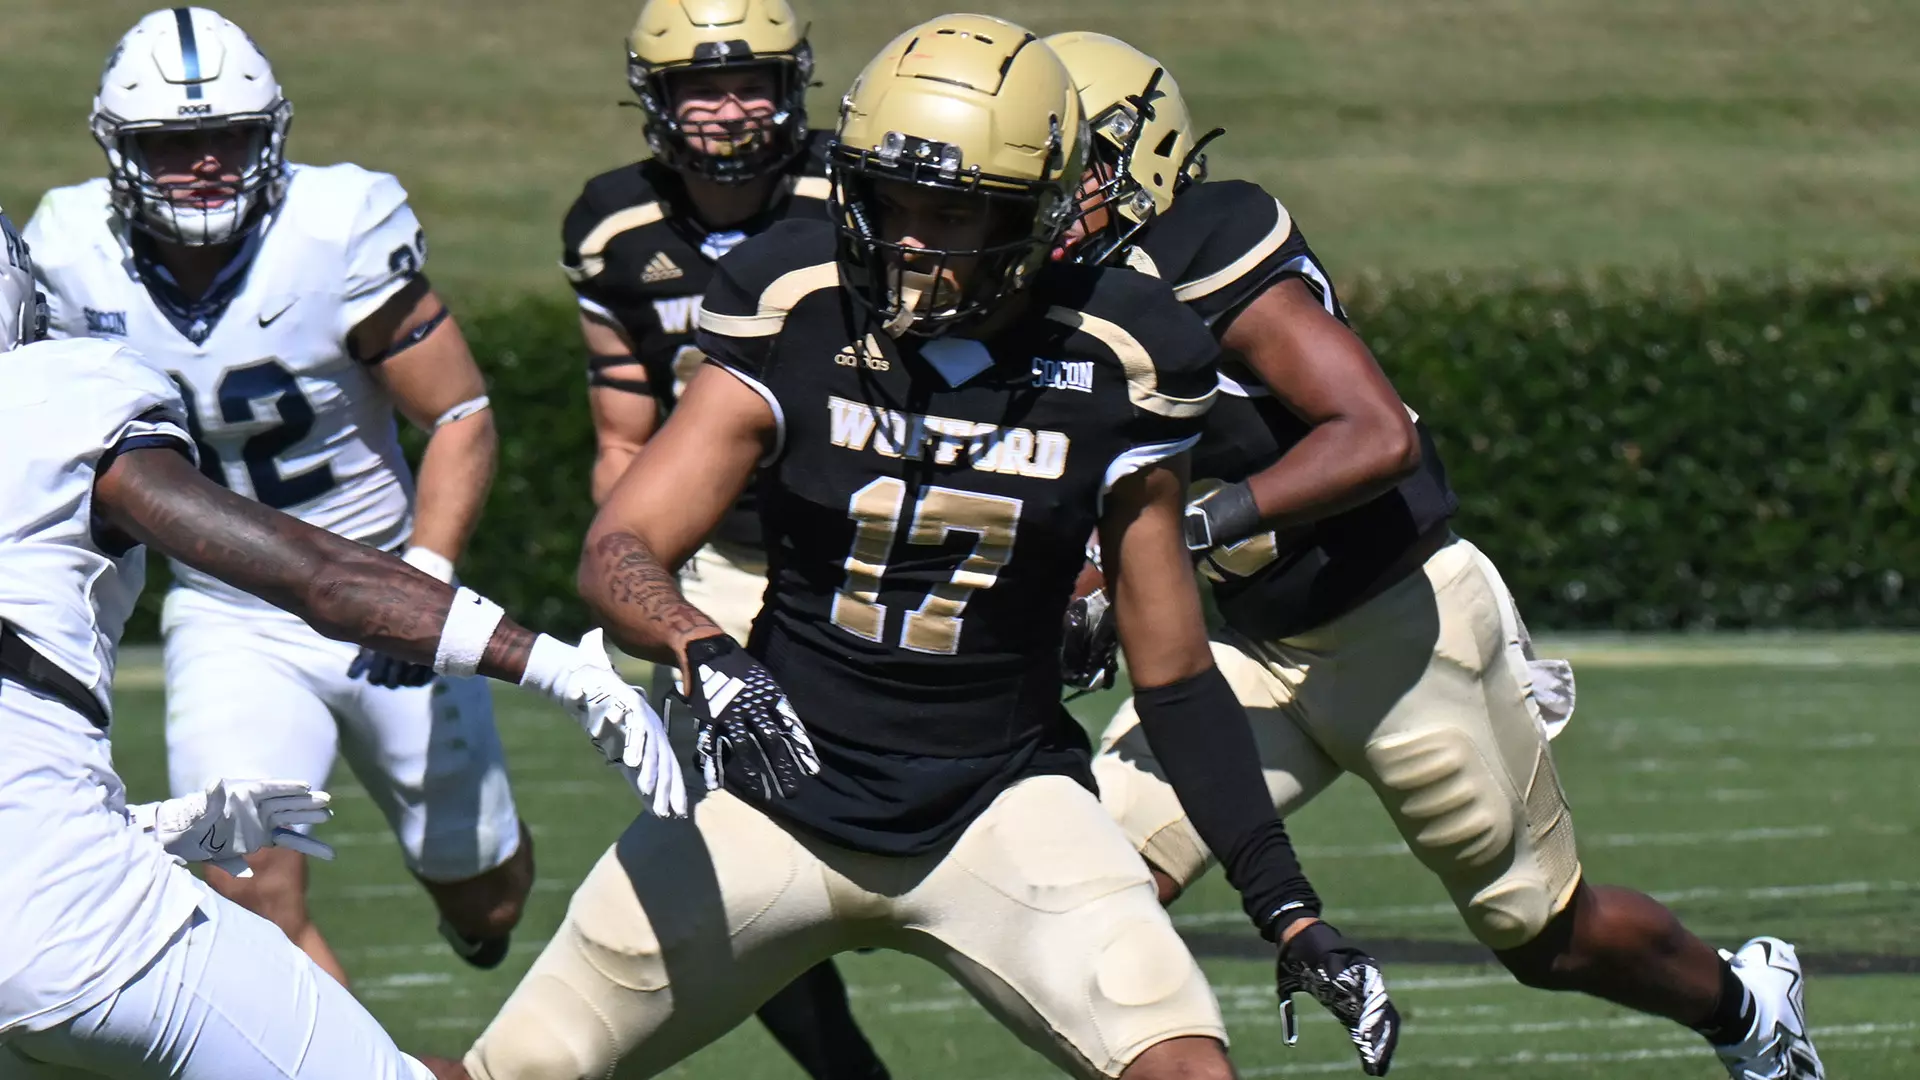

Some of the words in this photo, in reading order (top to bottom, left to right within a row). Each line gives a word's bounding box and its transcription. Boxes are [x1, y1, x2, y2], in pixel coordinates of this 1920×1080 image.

[1031, 356, 1095, 393] SOCON
[828, 395, 1071, 480] WOFFORD
[829, 475, 1024, 656] 17
